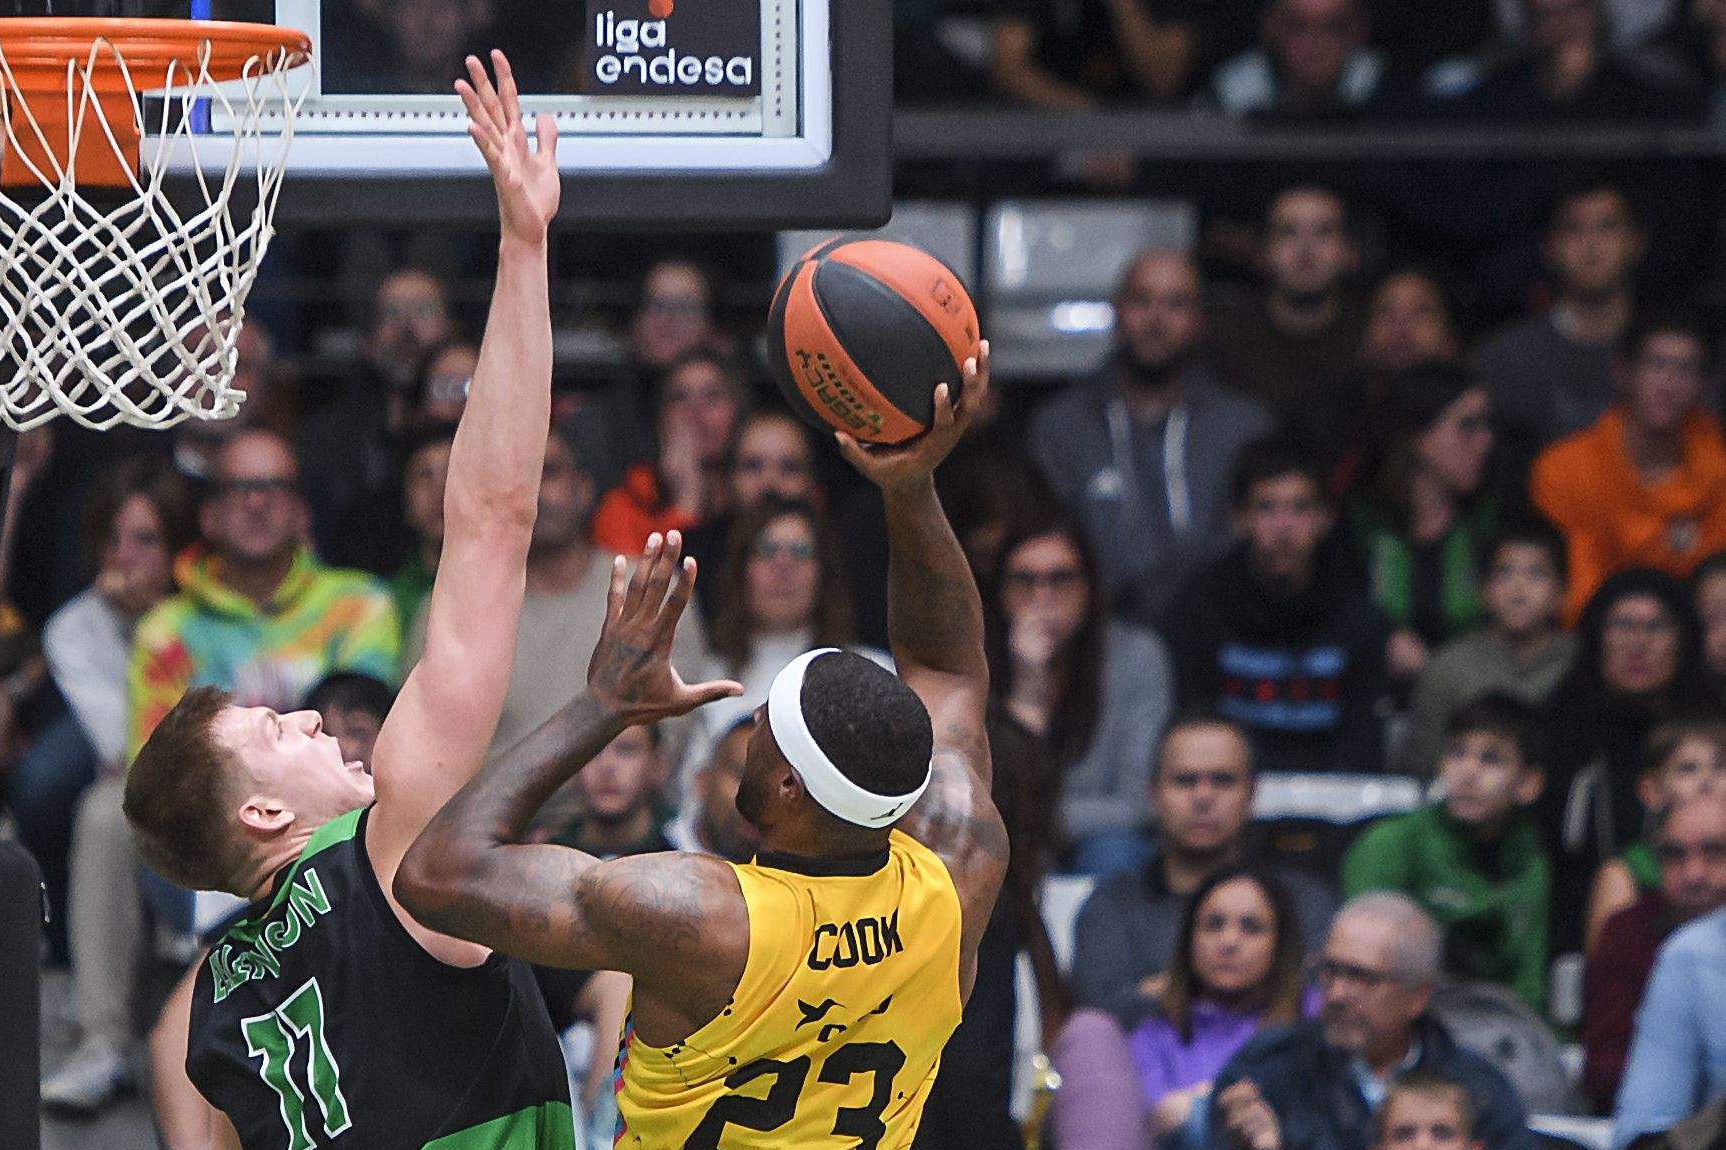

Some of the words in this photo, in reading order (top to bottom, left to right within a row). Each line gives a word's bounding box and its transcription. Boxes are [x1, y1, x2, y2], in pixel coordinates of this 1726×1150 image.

[596, 10, 667, 53] liga
[596, 47, 752, 86] endesa
[807, 907, 904, 971] COOK
